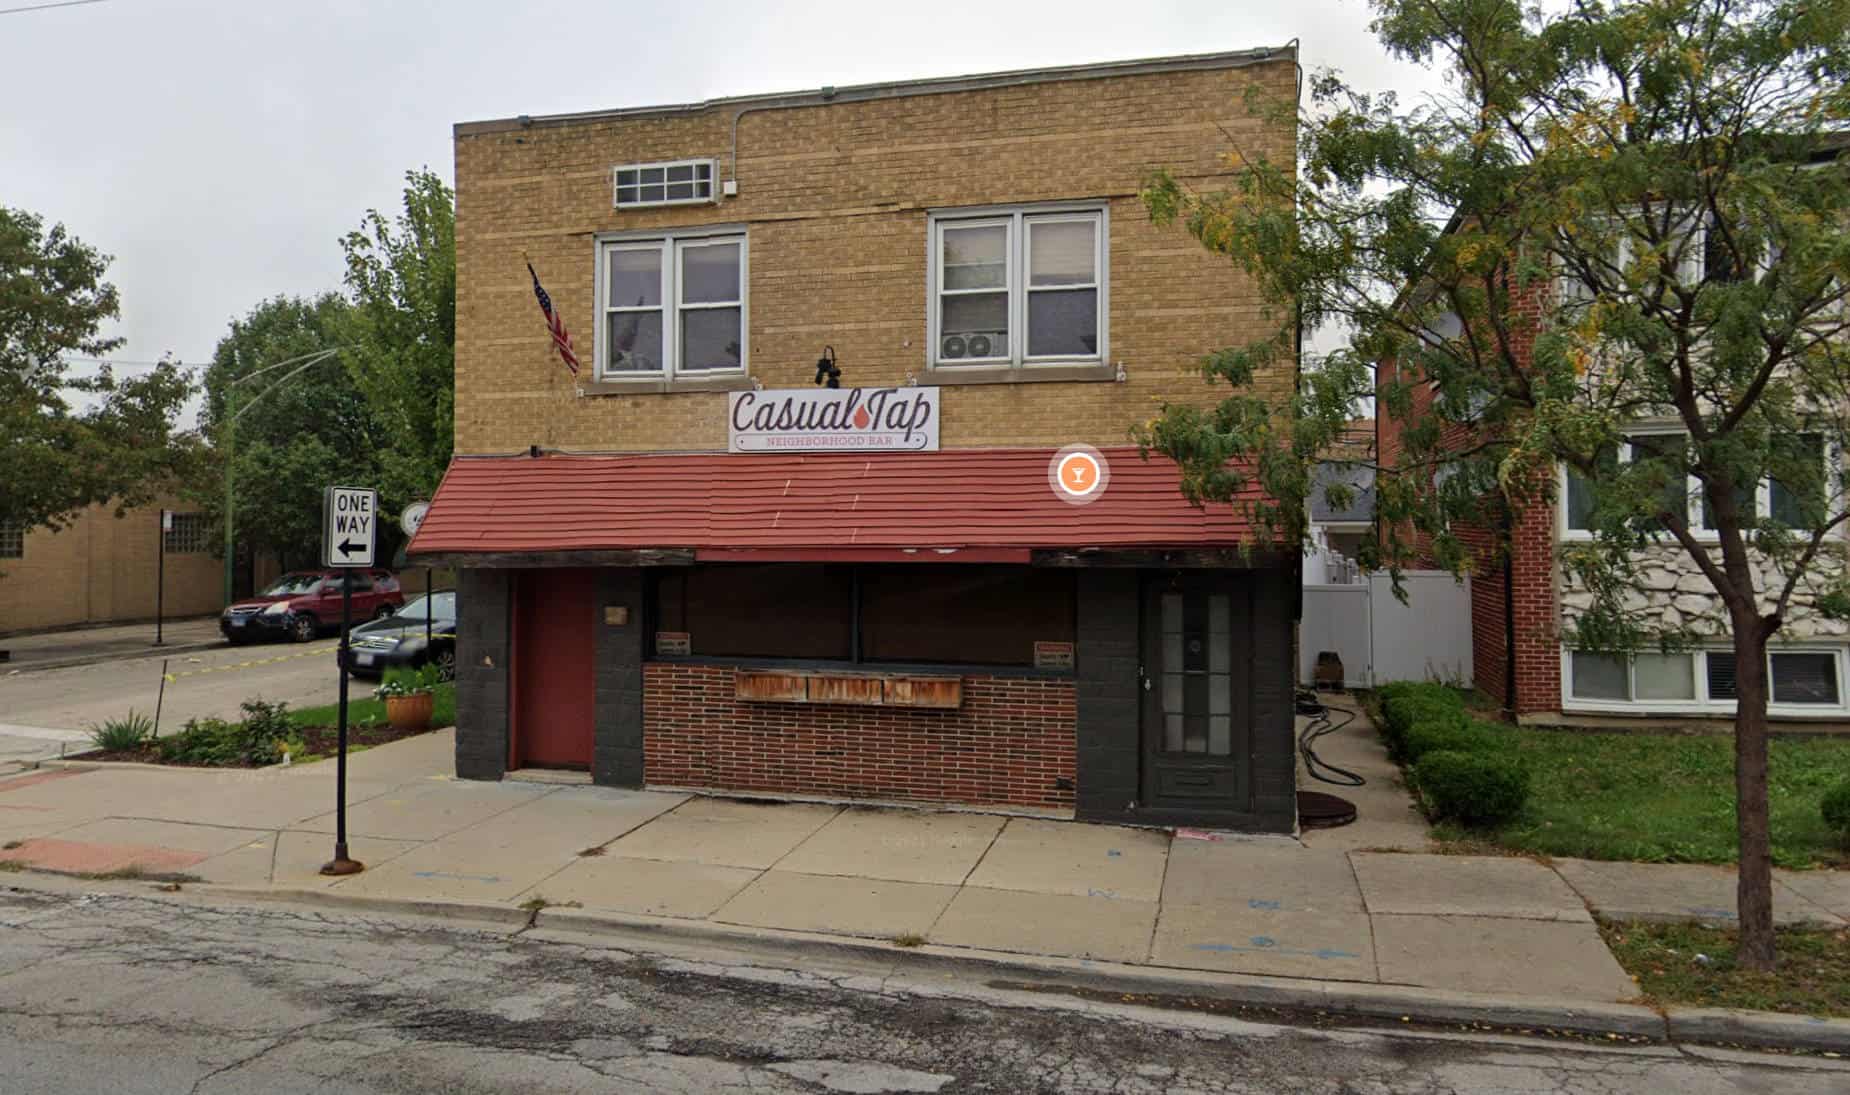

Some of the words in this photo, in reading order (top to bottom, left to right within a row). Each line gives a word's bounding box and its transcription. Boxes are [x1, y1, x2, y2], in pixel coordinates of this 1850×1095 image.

[733, 388, 861, 431] Casual
[867, 389, 931, 442] Tap
[766, 436, 865, 447] NEIGHBORHOOD
[868, 436, 893, 446] BAR
[338, 495, 369, 512] ONE
[336, 515, 370, 534] WAY
